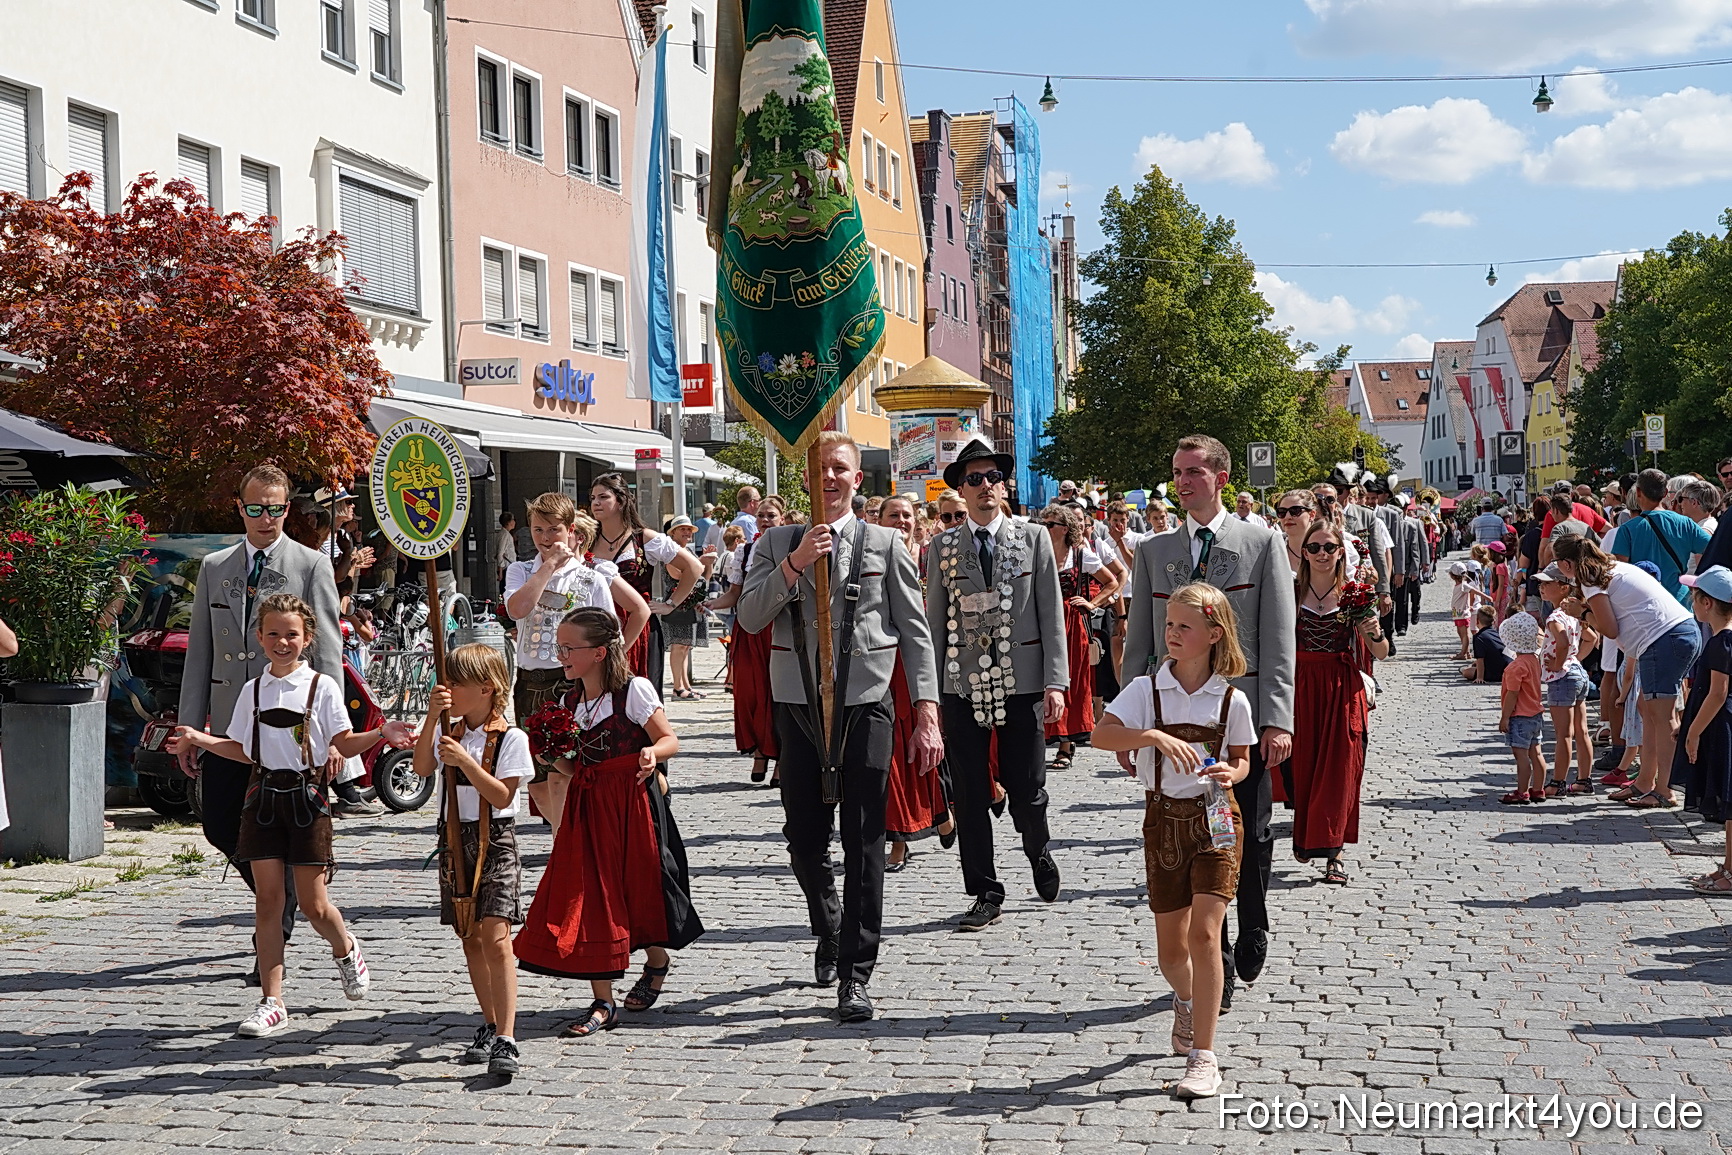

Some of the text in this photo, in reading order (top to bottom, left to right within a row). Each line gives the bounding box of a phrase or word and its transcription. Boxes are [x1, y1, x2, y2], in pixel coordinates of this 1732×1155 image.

[797, 283, 826, 302] am
[1651, 420, 1659, 428] H
[419, 422, 468, 511] HEINRICHSBURG
[393, 528, 458, 556] HOLZHEIM
